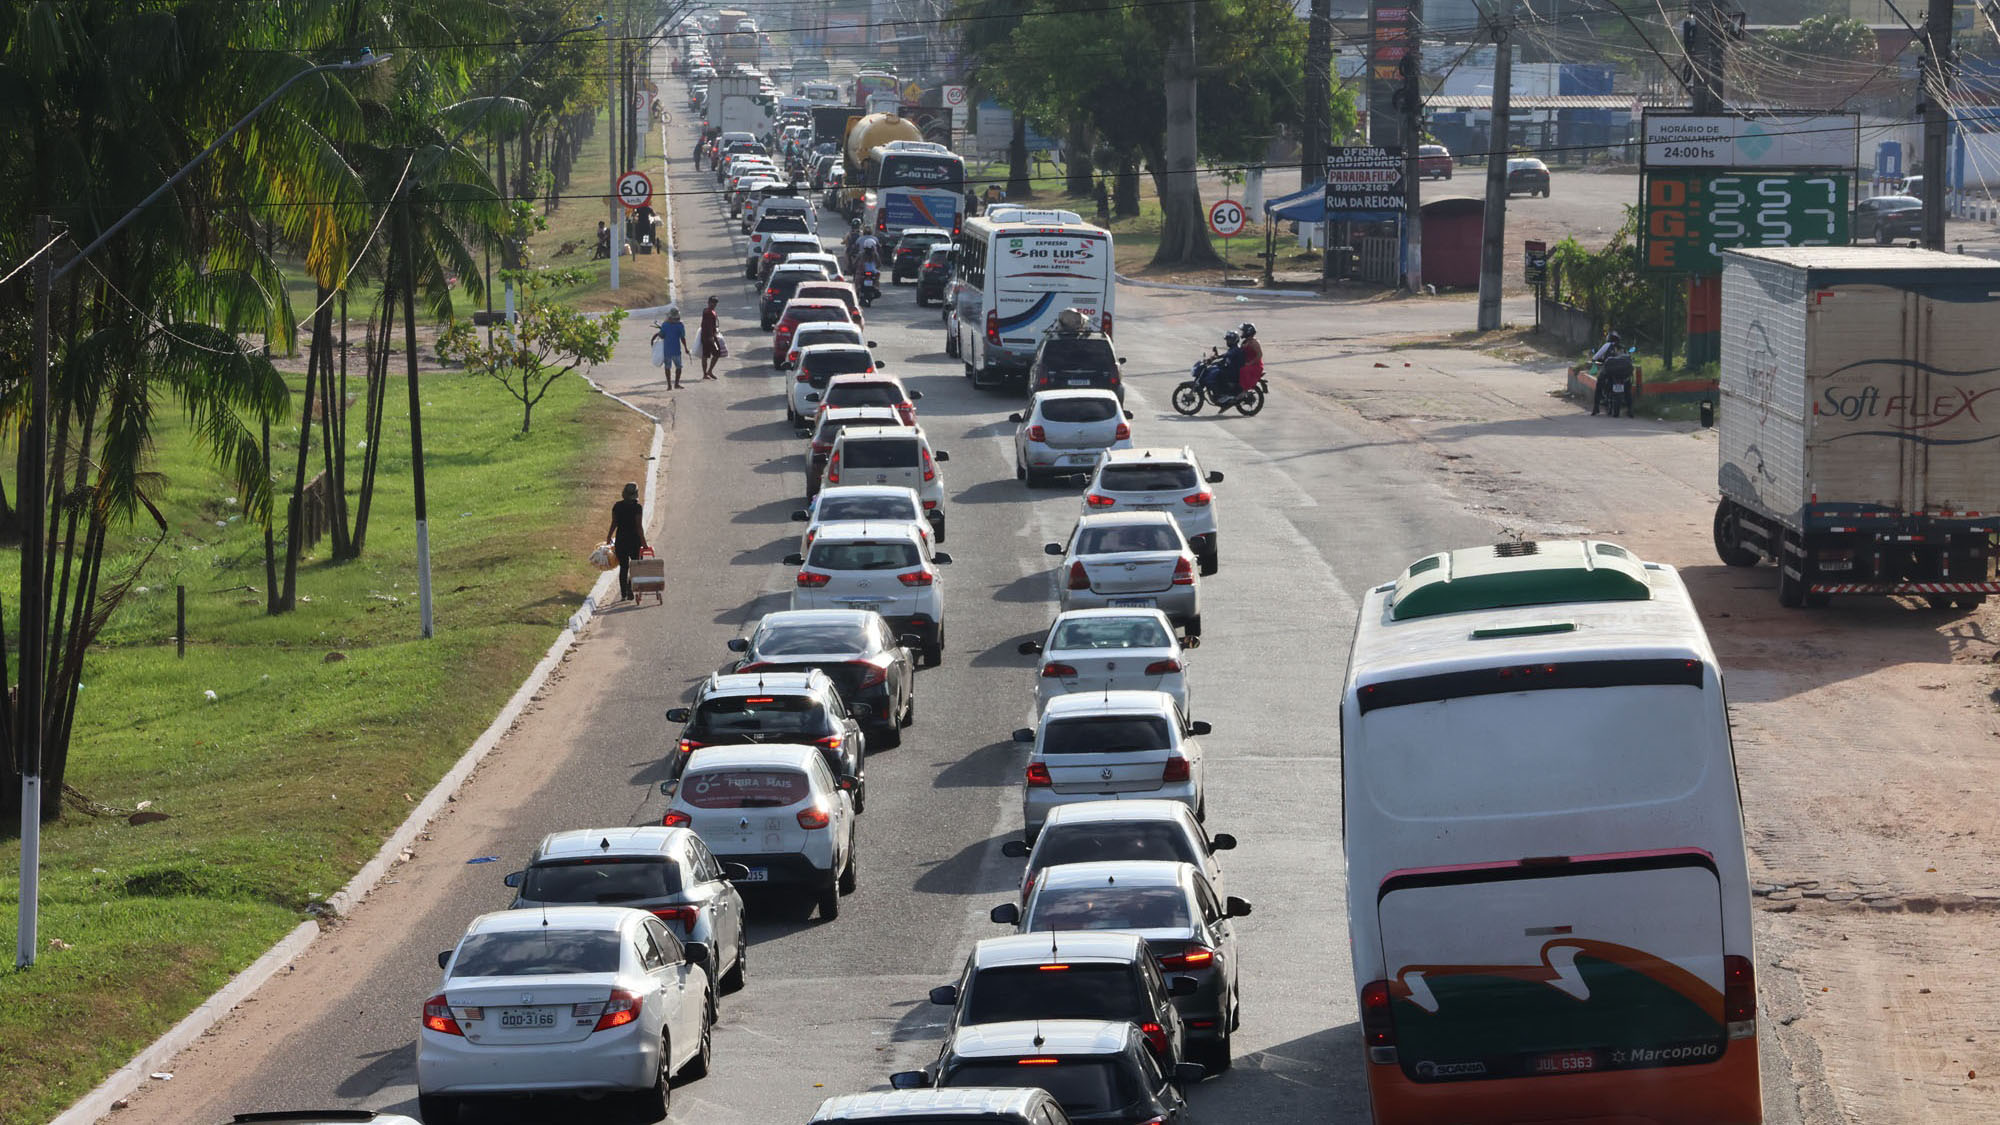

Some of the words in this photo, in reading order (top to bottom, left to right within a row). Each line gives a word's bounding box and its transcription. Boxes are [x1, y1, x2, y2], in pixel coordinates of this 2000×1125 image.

[1660, 125, 1704, 133] HORÁRIO
[1648, 135, 1732, 143] FUNCIONAMENTO
[1343, 148, 1386, 156] OFICINA
[1664, 147, 1699, 158] 24:00
[1701, 147, 1715, 158] hs
[1327, 156, 1402, 167] RADIADORES
[1372, 171, 1398, 181] FILHO
[620, 180, 648, 196] 60
[1650, 180, 1686, 206] D
[1327, 196, 1348, 208] RUA
[1350, 198, 1363, 208] DA
[1364, 196, 1404, 208] REICON
[1214, 208, 1241, 224] 60
[1650, 210, 1686, 237] G
[1650, 240, 1676, 266] E
[1819, 386, 1880, 421] Soft
[1884, 386, 1984, 427] FLEX
[728, 778, 759, 787] FIBRA
[766, 777, 793, 788] MAIS
[1631, 1045, 1717, 1060] Marcopolo
[1536, 1059, 1557, 1070] JUL
[1562, 1057, 1592, 1069] 6363
